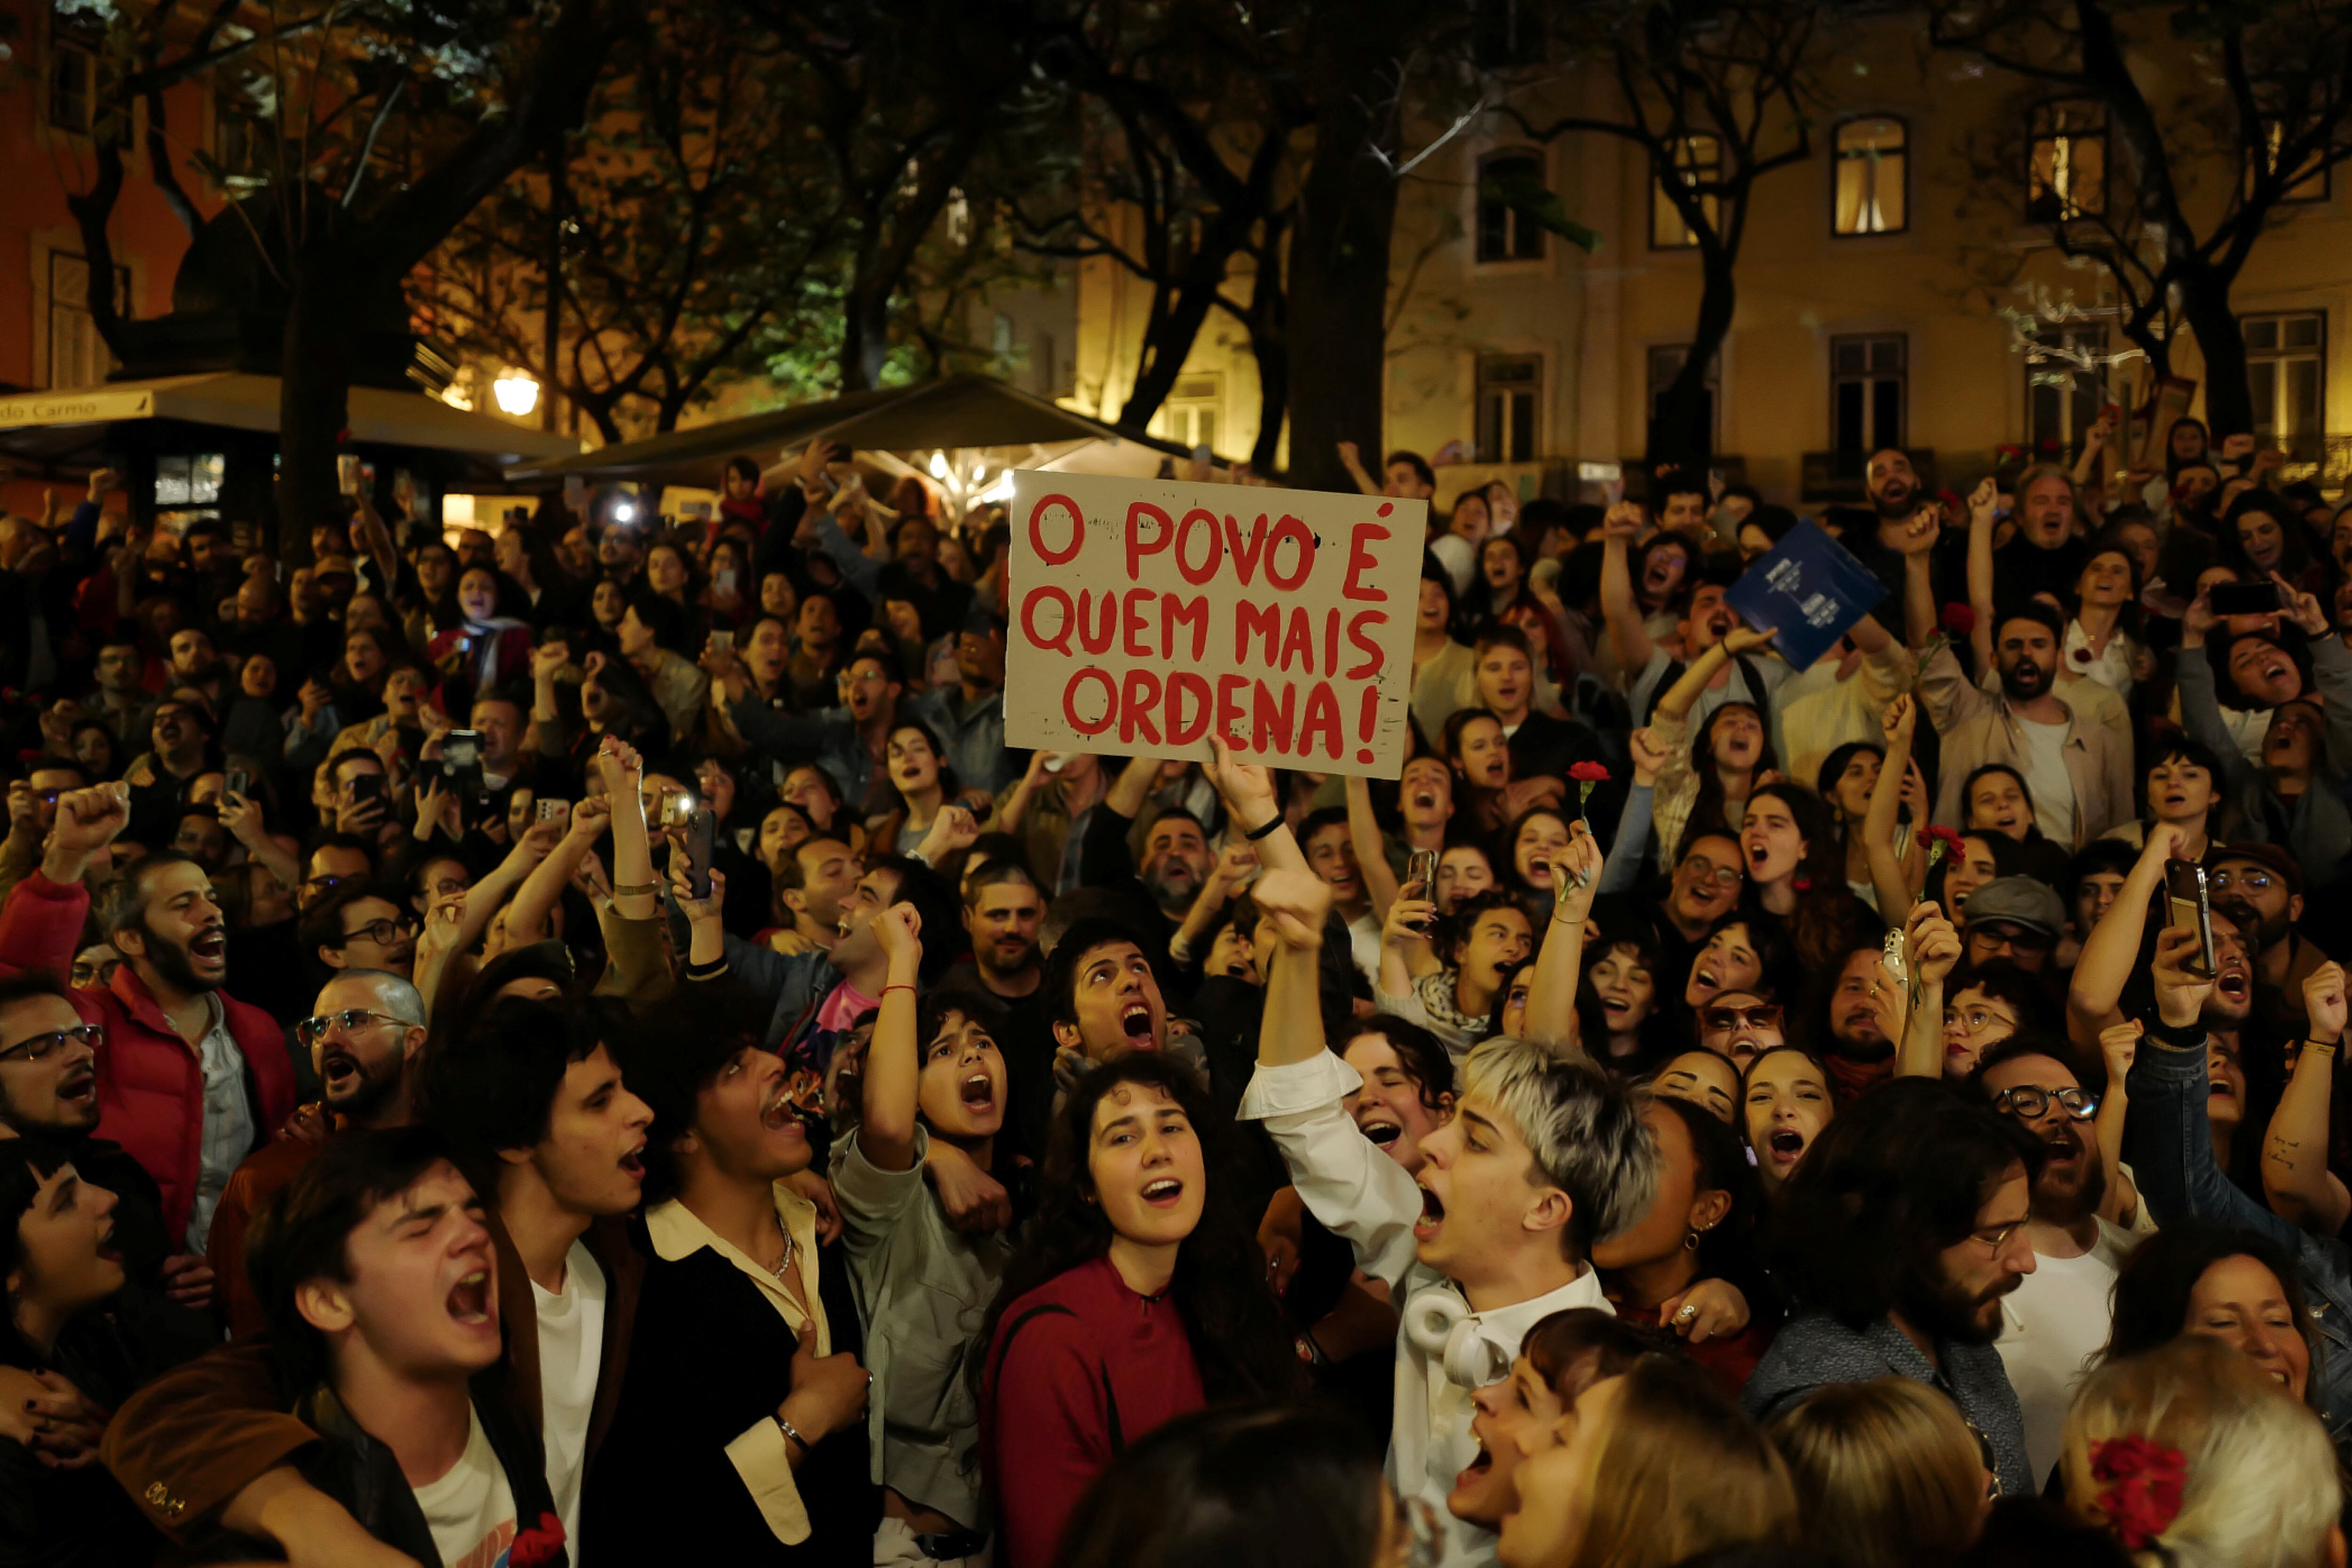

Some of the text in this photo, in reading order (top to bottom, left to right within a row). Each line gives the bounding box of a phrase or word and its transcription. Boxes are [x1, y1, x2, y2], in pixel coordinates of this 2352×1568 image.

[32, 402, 96, 418] Carmo
[1029, 493, 1393, 602] O POVO É
[1021, 585, 1388, 680] QUEM MAIS
[1063, 667, 1379, 764] ORDENA!
